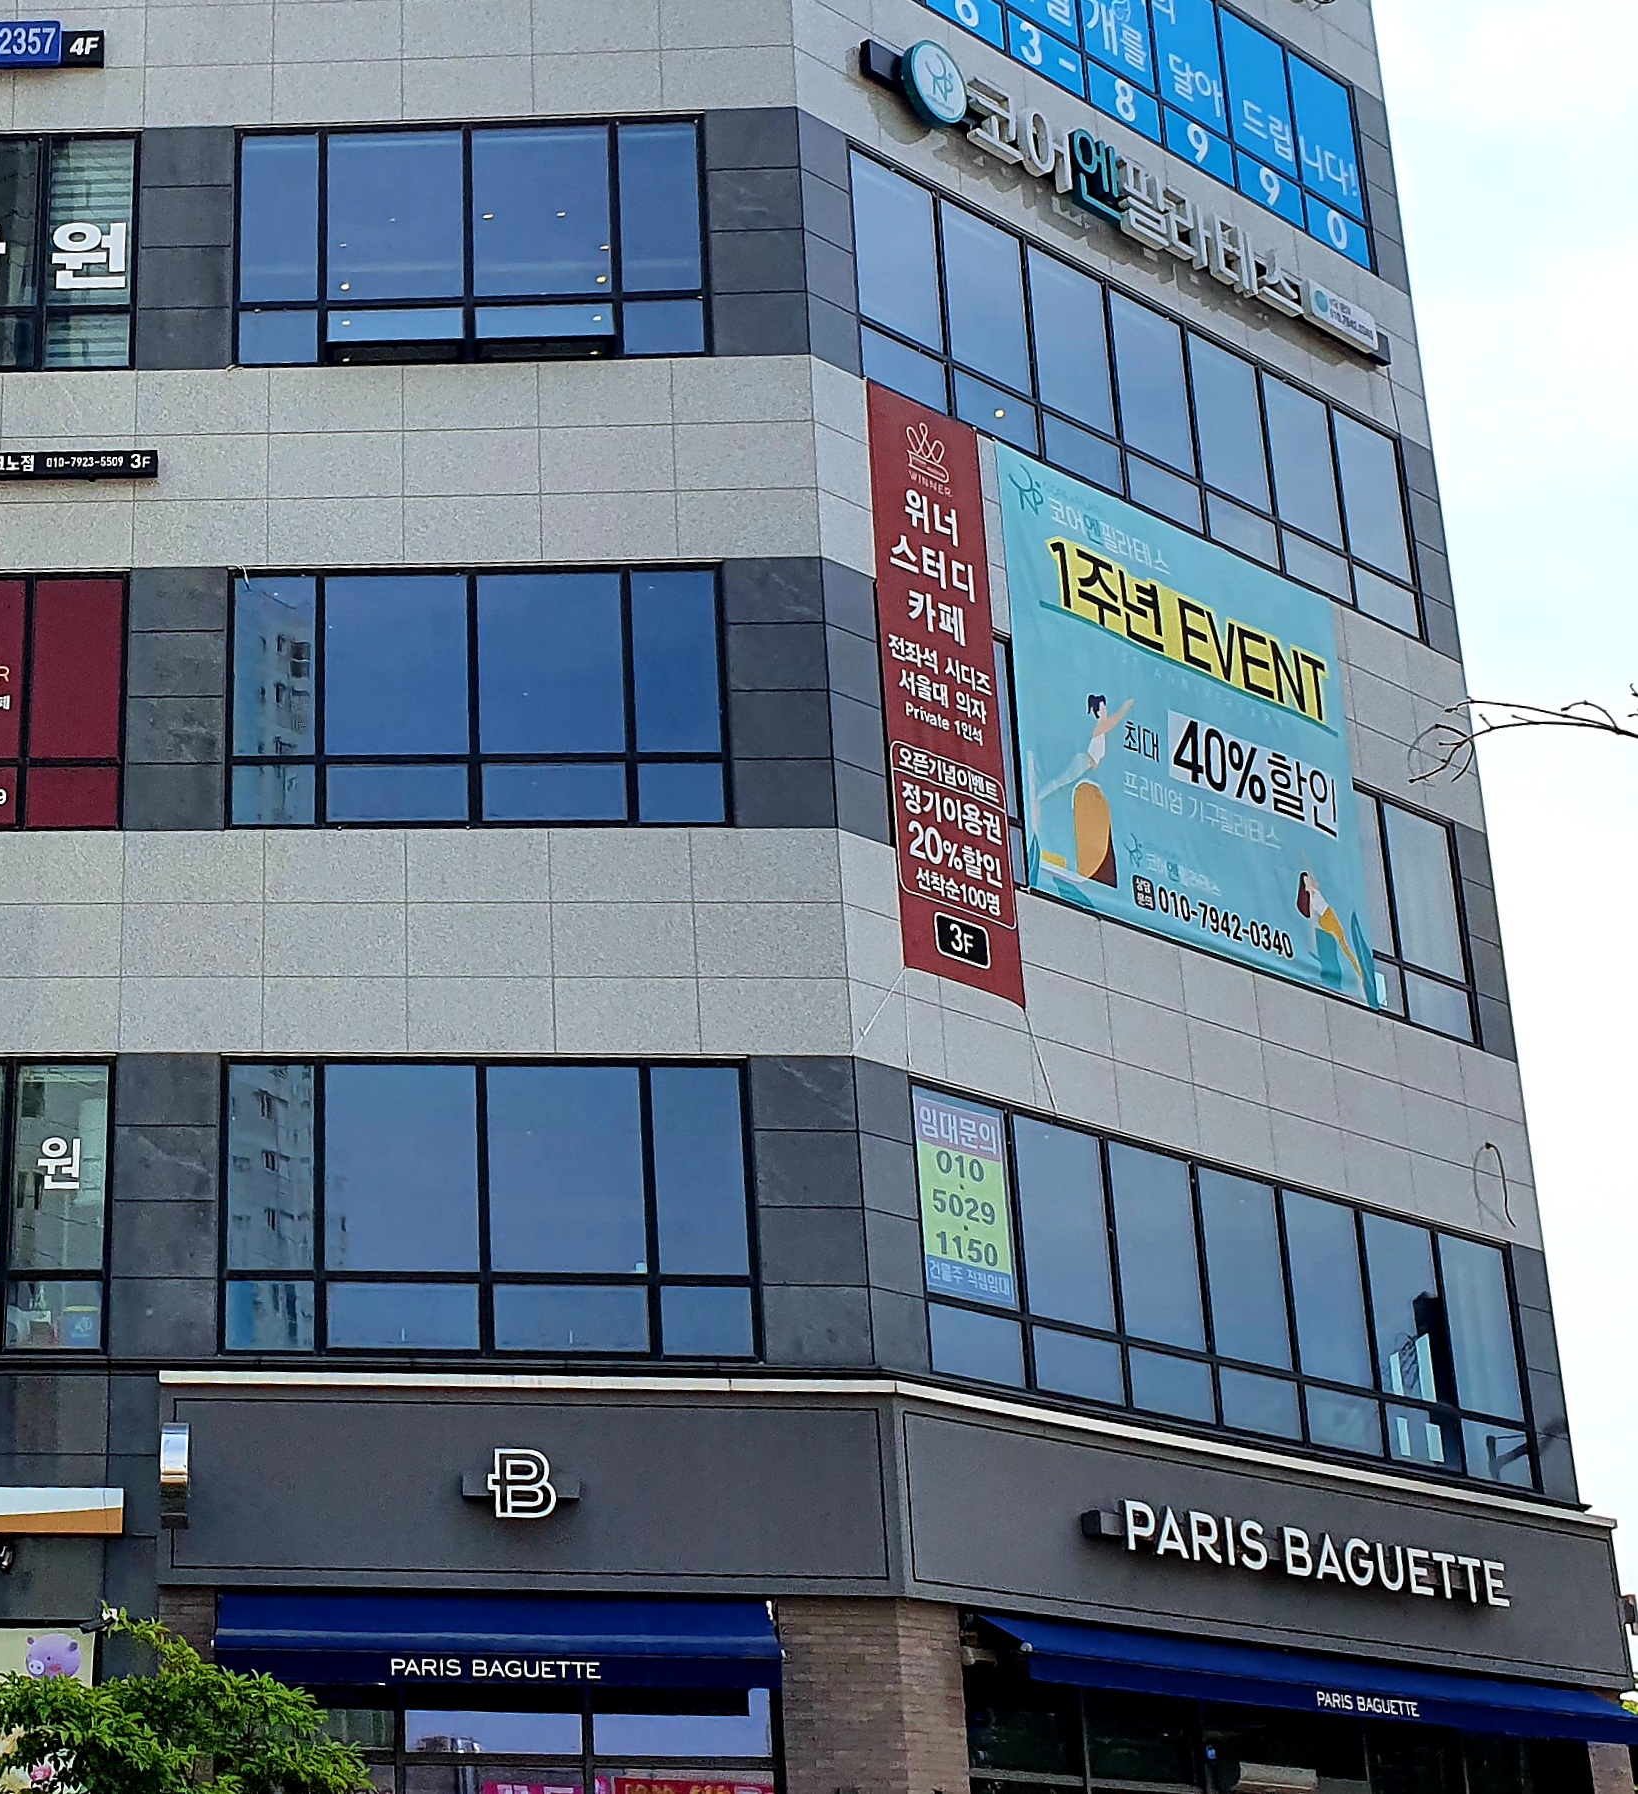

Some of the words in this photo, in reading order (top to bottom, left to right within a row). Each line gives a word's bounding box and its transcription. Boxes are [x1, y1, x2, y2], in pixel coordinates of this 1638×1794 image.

[70, 35, 101, 57] 4F
[1168, 53, 1224, 118] 달아
[1242, 99, 1358, 197] 드립니다!
[46, 456, 123, 468] 010-7923-5509
[131, 454, 151, 469] 3F
[909, 470, 954, 498] WINNER
[904, 489, 960, 548] 위너
[890, 535, 976, 604] 스터디
[908, 587, 966, 647] 카페
[1050, 542, 1164, 652] 1주년
[1178, 598, 1328, 722] EVENT
[889, 633, 940, 675] 전좌석
[944, 659, 992, 696] 시디즈
[899, 666, 949, 708] 서울대
[955, 692, 988, 726] 의자
[905, 701, 952, 732] Private
[955, 715, 984, 747] 1인석
[898, 748, 999, 802] 오픈기념이벤트
[1123, 721, 1159, 763] 최대
[1172, 719, 1339, 838] 40%할인
[1123, 771, 1183, 816] 프리미엄
[901, 780, 1003, 846] 정기이용권
[908, 821, 1003, 889] 20%할인
[915, 865, 1002, 916] 선착순100명
[950, 922, 974, 954] 3F
[1158, 886, 1294, 959] 010-7942-0340
[919, 1105, 997, 1156] 임대문의
[936, 1150, 985, 1182] 010
[932, 1188, 996, 1226] 5029
[936, 1231, 998, 1267] 1150
[1123, 1499, 1268, 1571] PARIS
[1282, 1525, 1510, 1608] BAGUETTE
[391, 1658, 461, 1677] PARIS
[472, 1660, 601, 1680] BAGUETTE
[1316, 1691, 1353, 1711] PARIS
[1357, 1694, 1420, 1717] BAGUETTE
